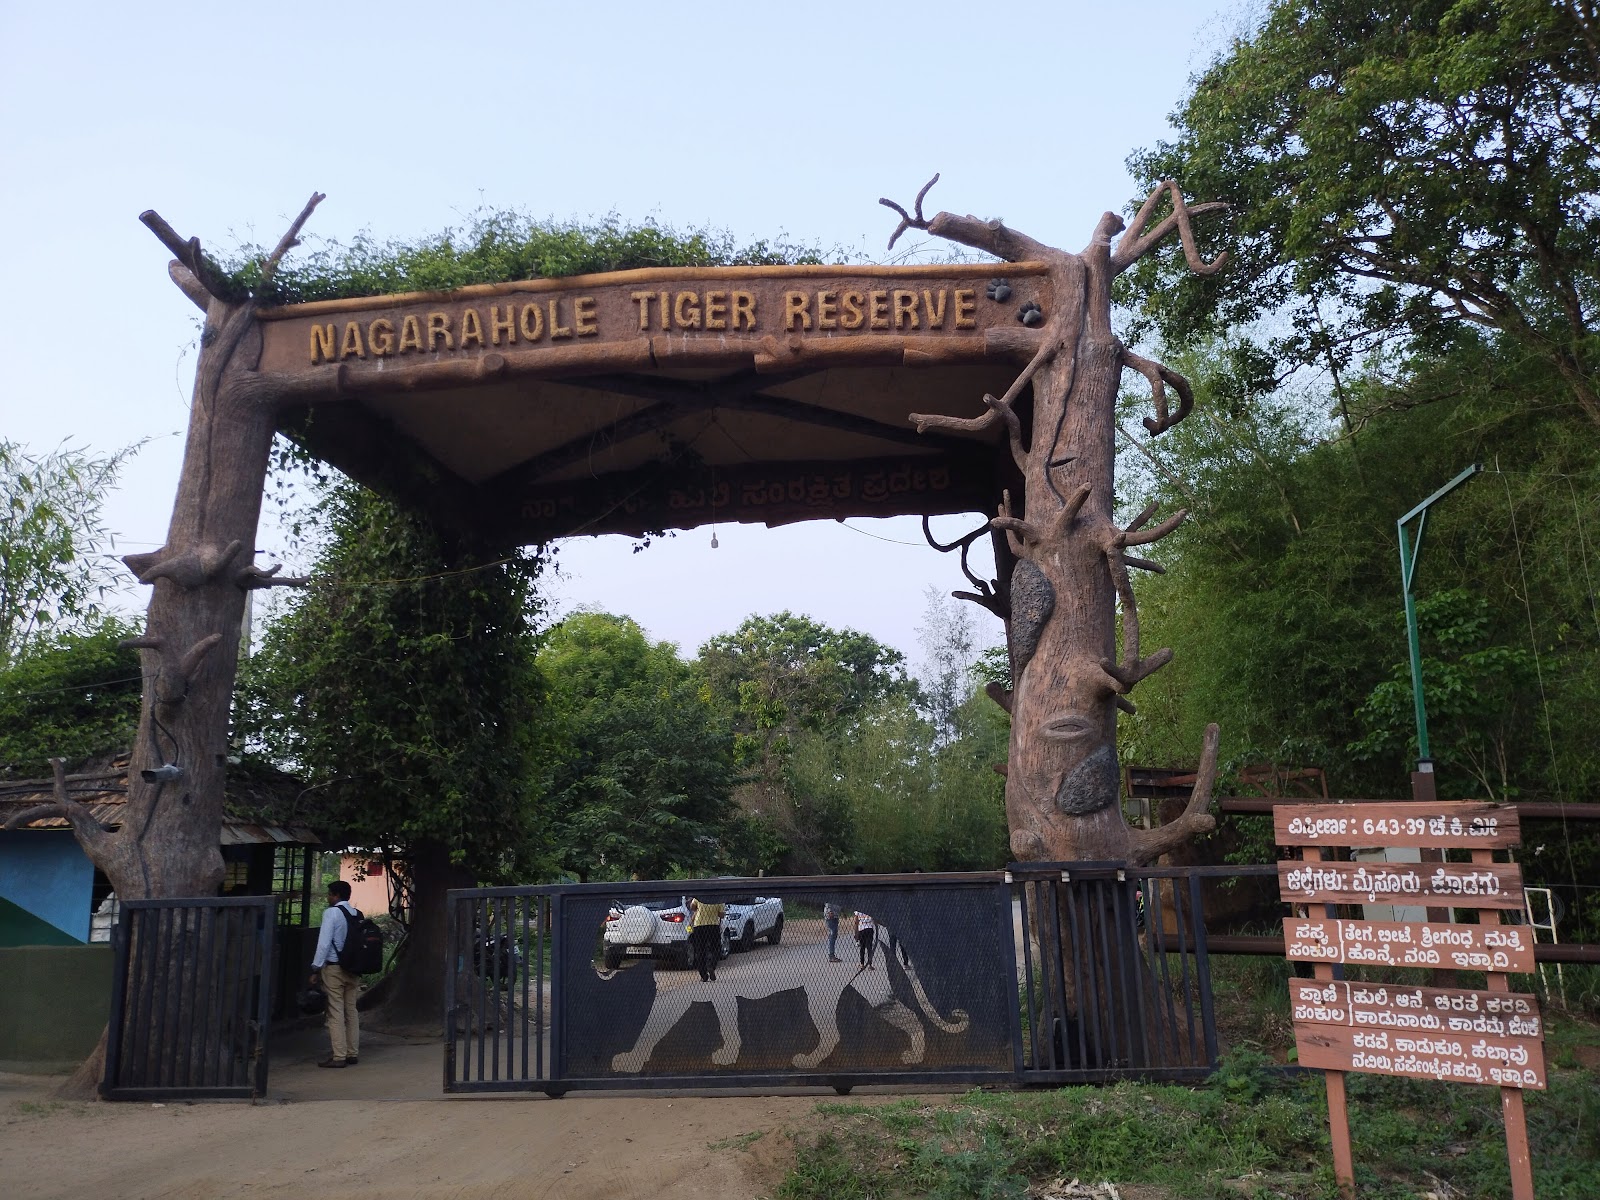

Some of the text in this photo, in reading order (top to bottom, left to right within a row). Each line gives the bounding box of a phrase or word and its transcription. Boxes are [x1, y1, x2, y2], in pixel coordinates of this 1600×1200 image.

[310, 289, 976, 365] NAGARAHOLE TIGER RESERVE
